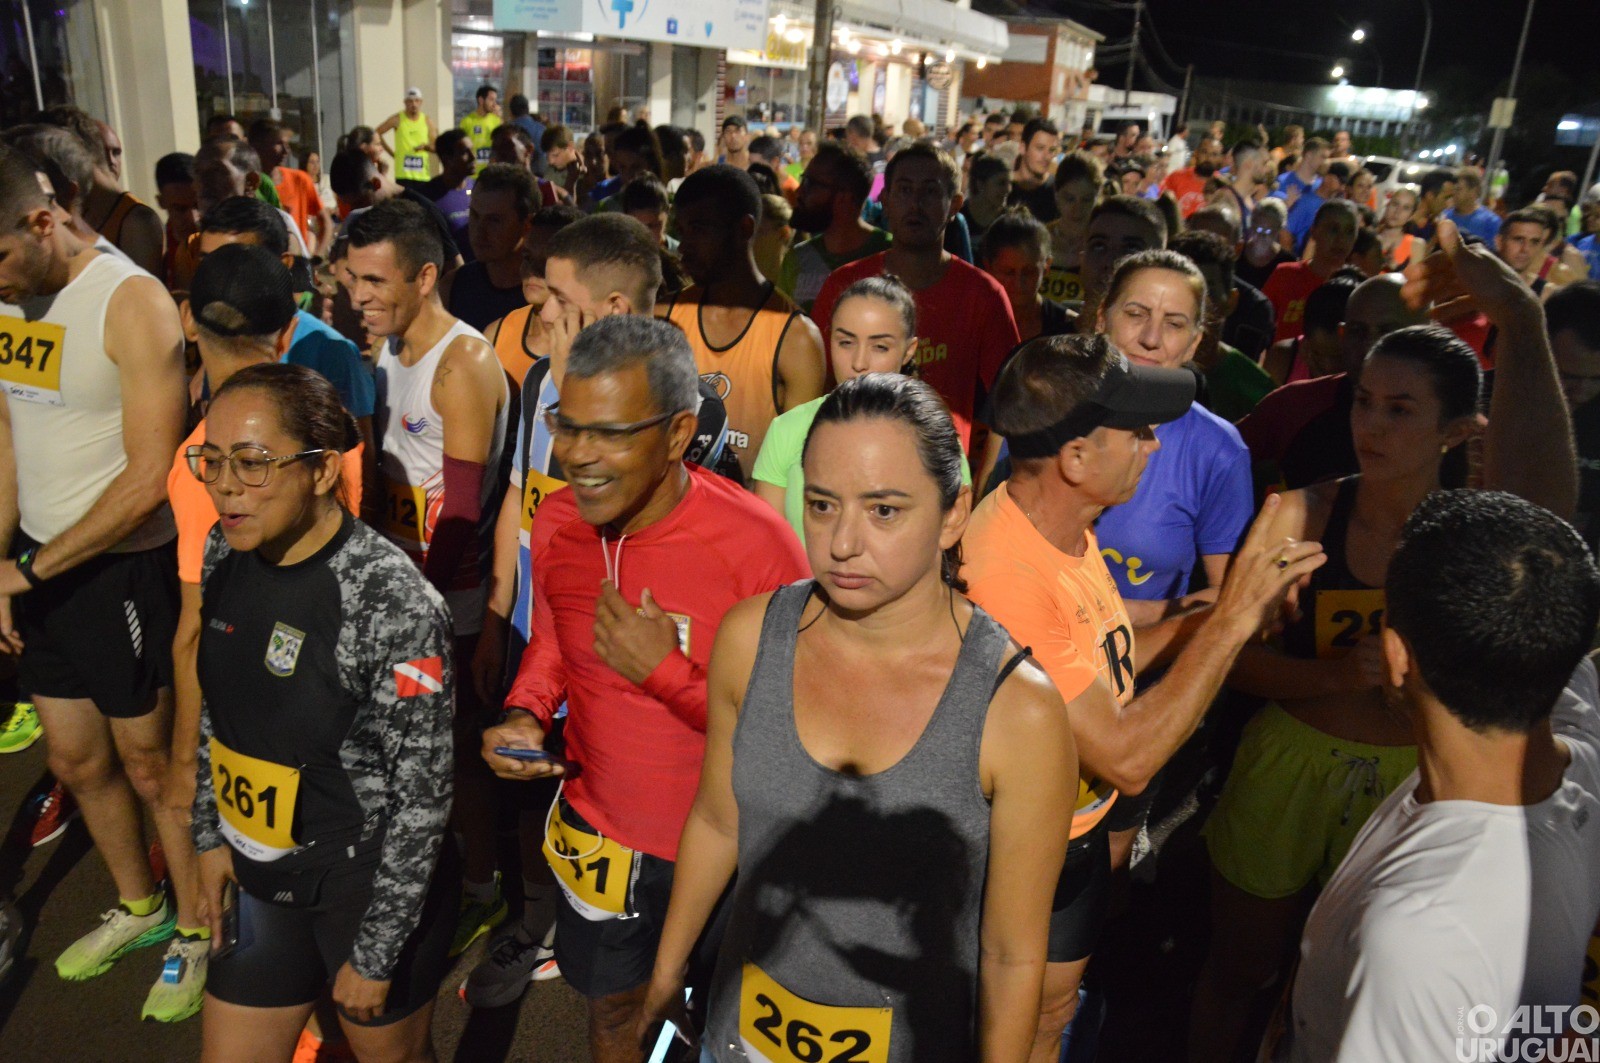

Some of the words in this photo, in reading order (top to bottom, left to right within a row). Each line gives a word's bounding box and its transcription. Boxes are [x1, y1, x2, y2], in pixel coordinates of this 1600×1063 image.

[0, 332, 55, 372] 347
[218, 764, 278, 829] 261
[753, 993, 872, 1063] 262
